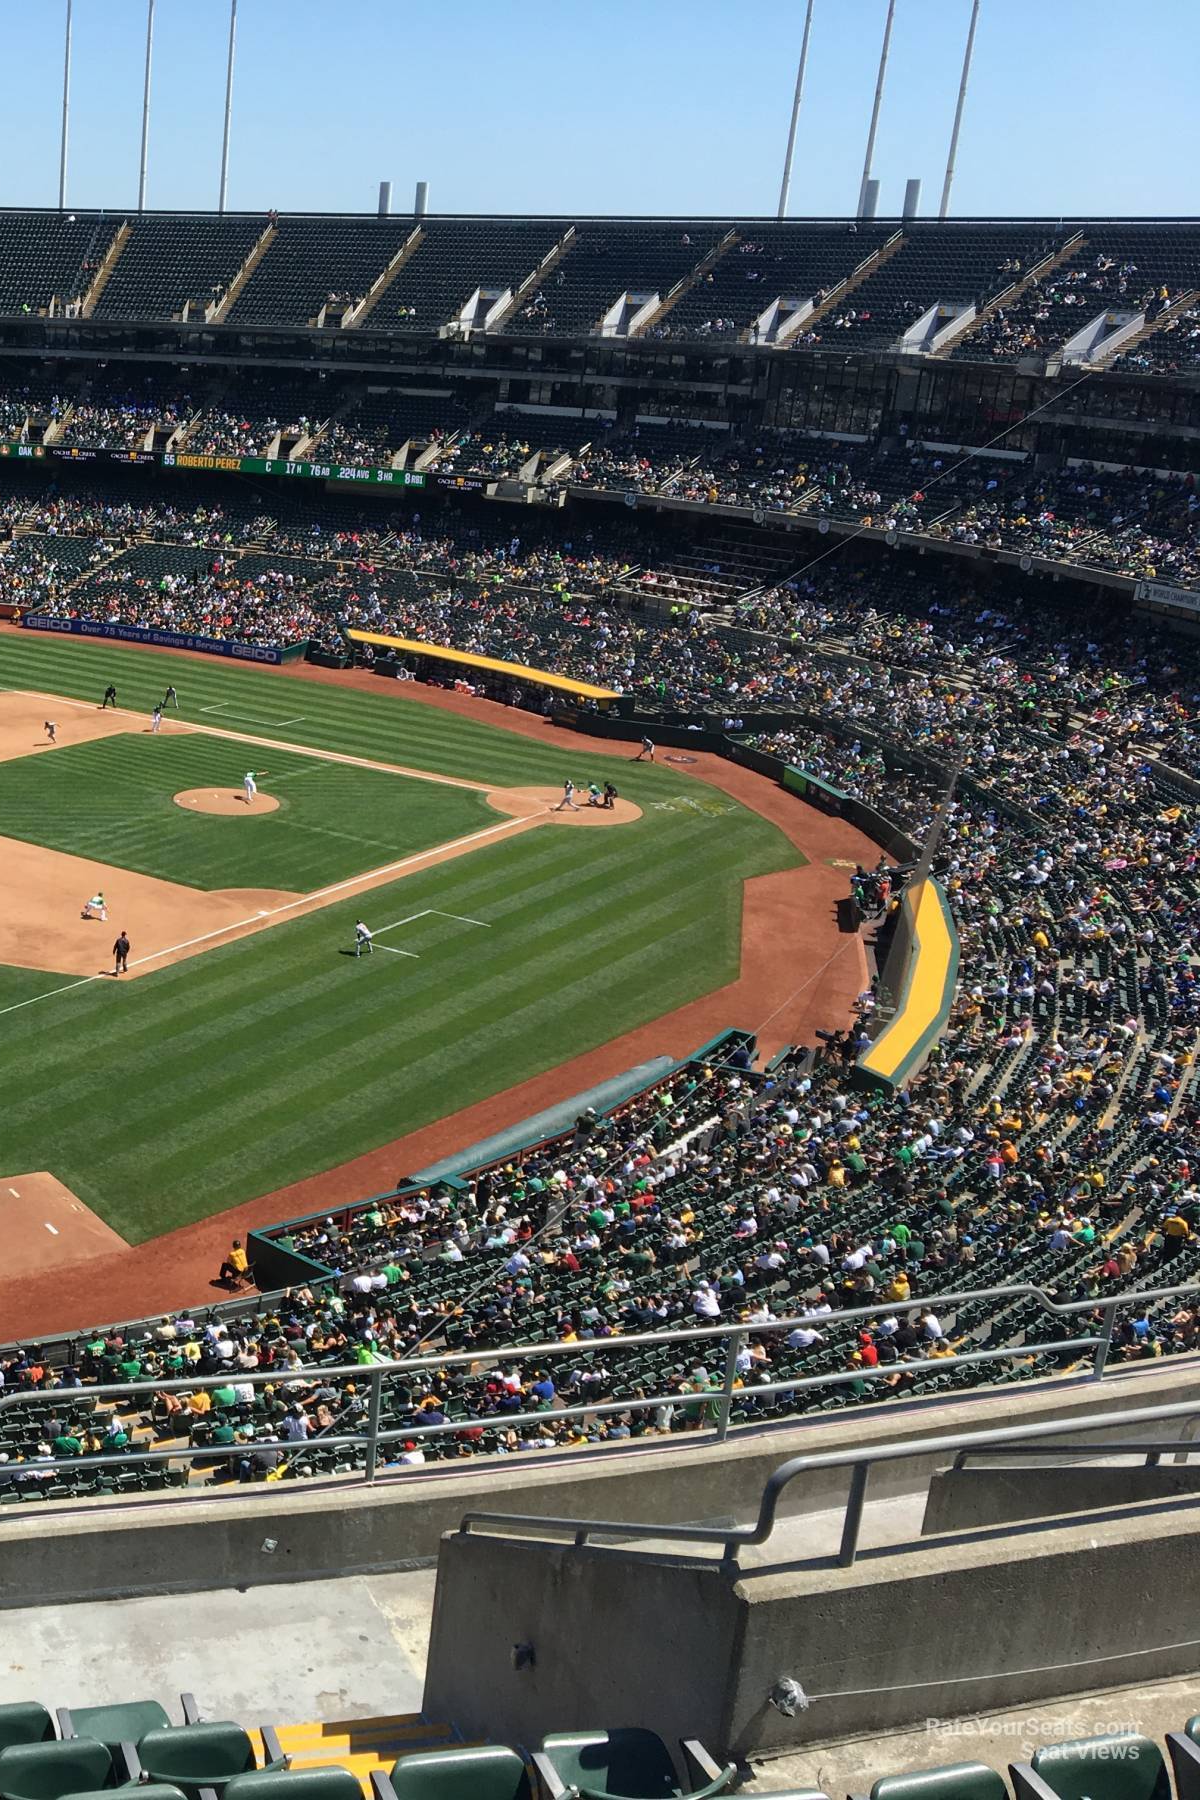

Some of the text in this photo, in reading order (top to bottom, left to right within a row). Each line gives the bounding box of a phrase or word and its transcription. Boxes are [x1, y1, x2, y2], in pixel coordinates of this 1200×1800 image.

[18, 445, 32, 457] OAK
[78, 450, 97, 458] CREEK
[164, 454, 424, 485] 55 ROBERTO PEREZ C 17 76 AB .224 AVG 3 HR 8 RBI
[463, 480, 483, 488] CREEK
[26, 618, 277, 662] GEICO Over 75 Years of Savings & Service GEICO
